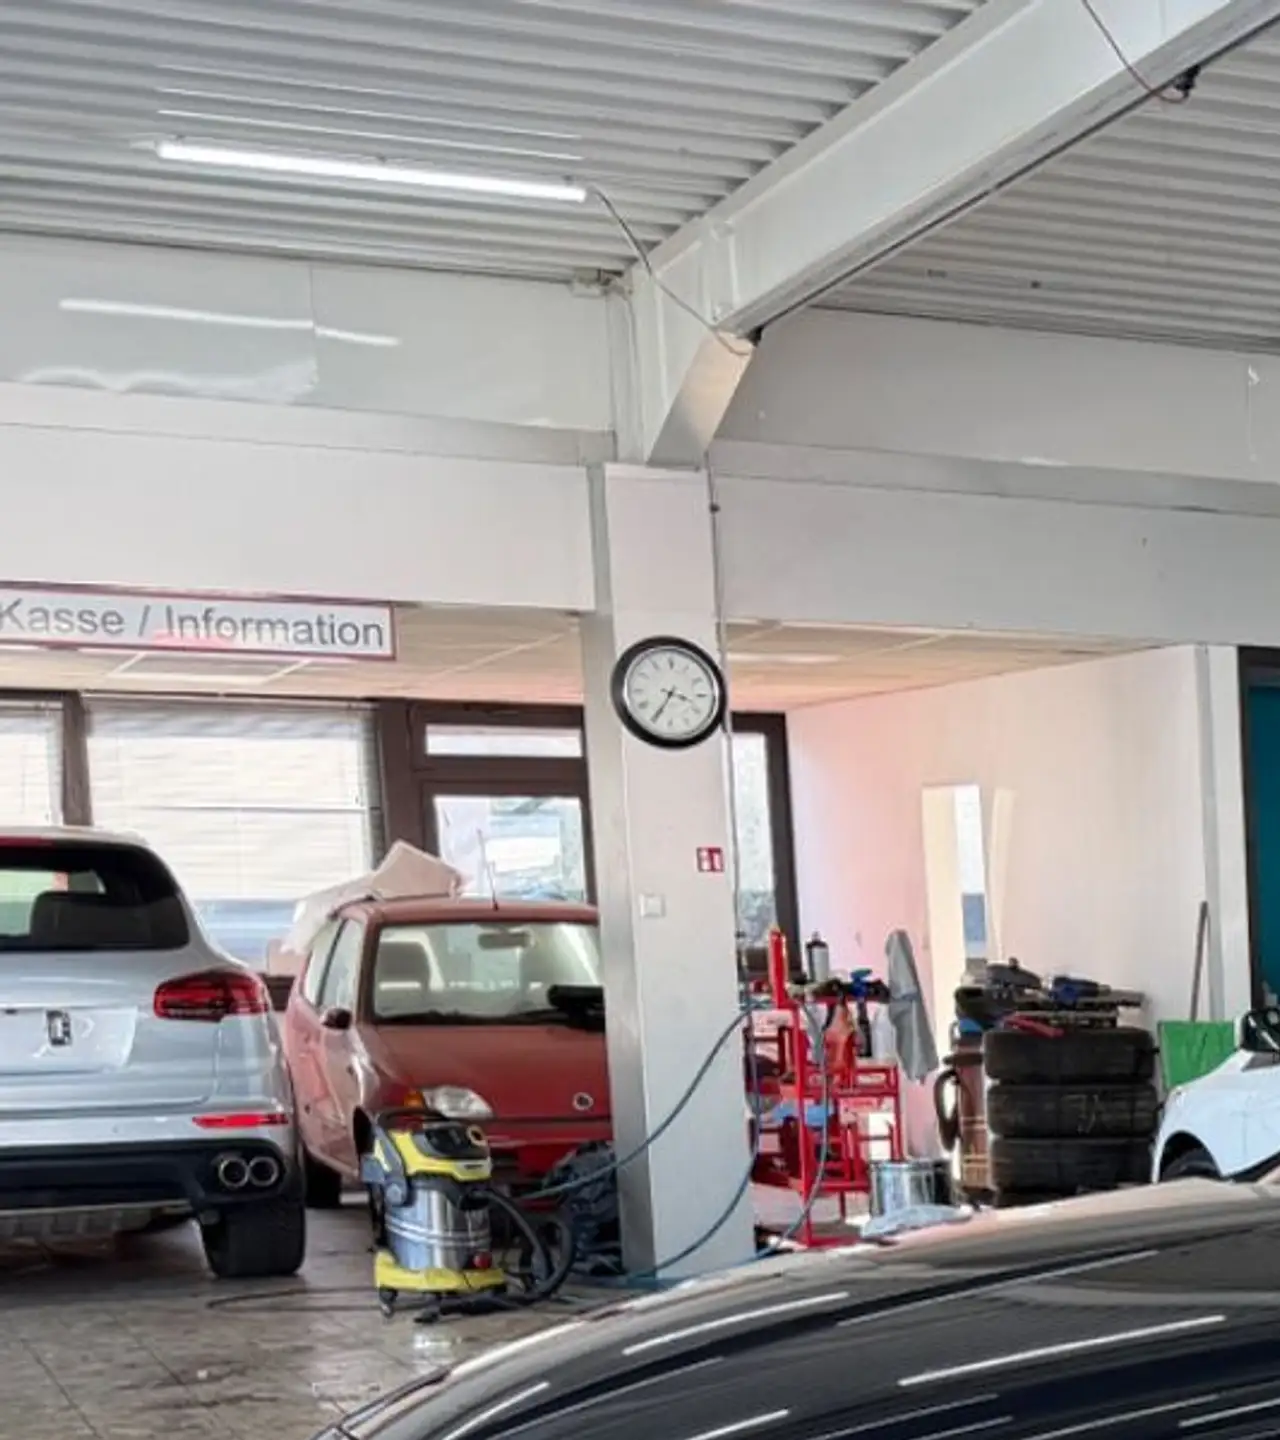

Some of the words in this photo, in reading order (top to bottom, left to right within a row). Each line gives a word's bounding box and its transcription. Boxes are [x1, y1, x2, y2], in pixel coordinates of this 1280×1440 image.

[0, 598, 125, 635] Kasse
[137, 603, 151, 637] /
[165, 604, 384, 648] Information
